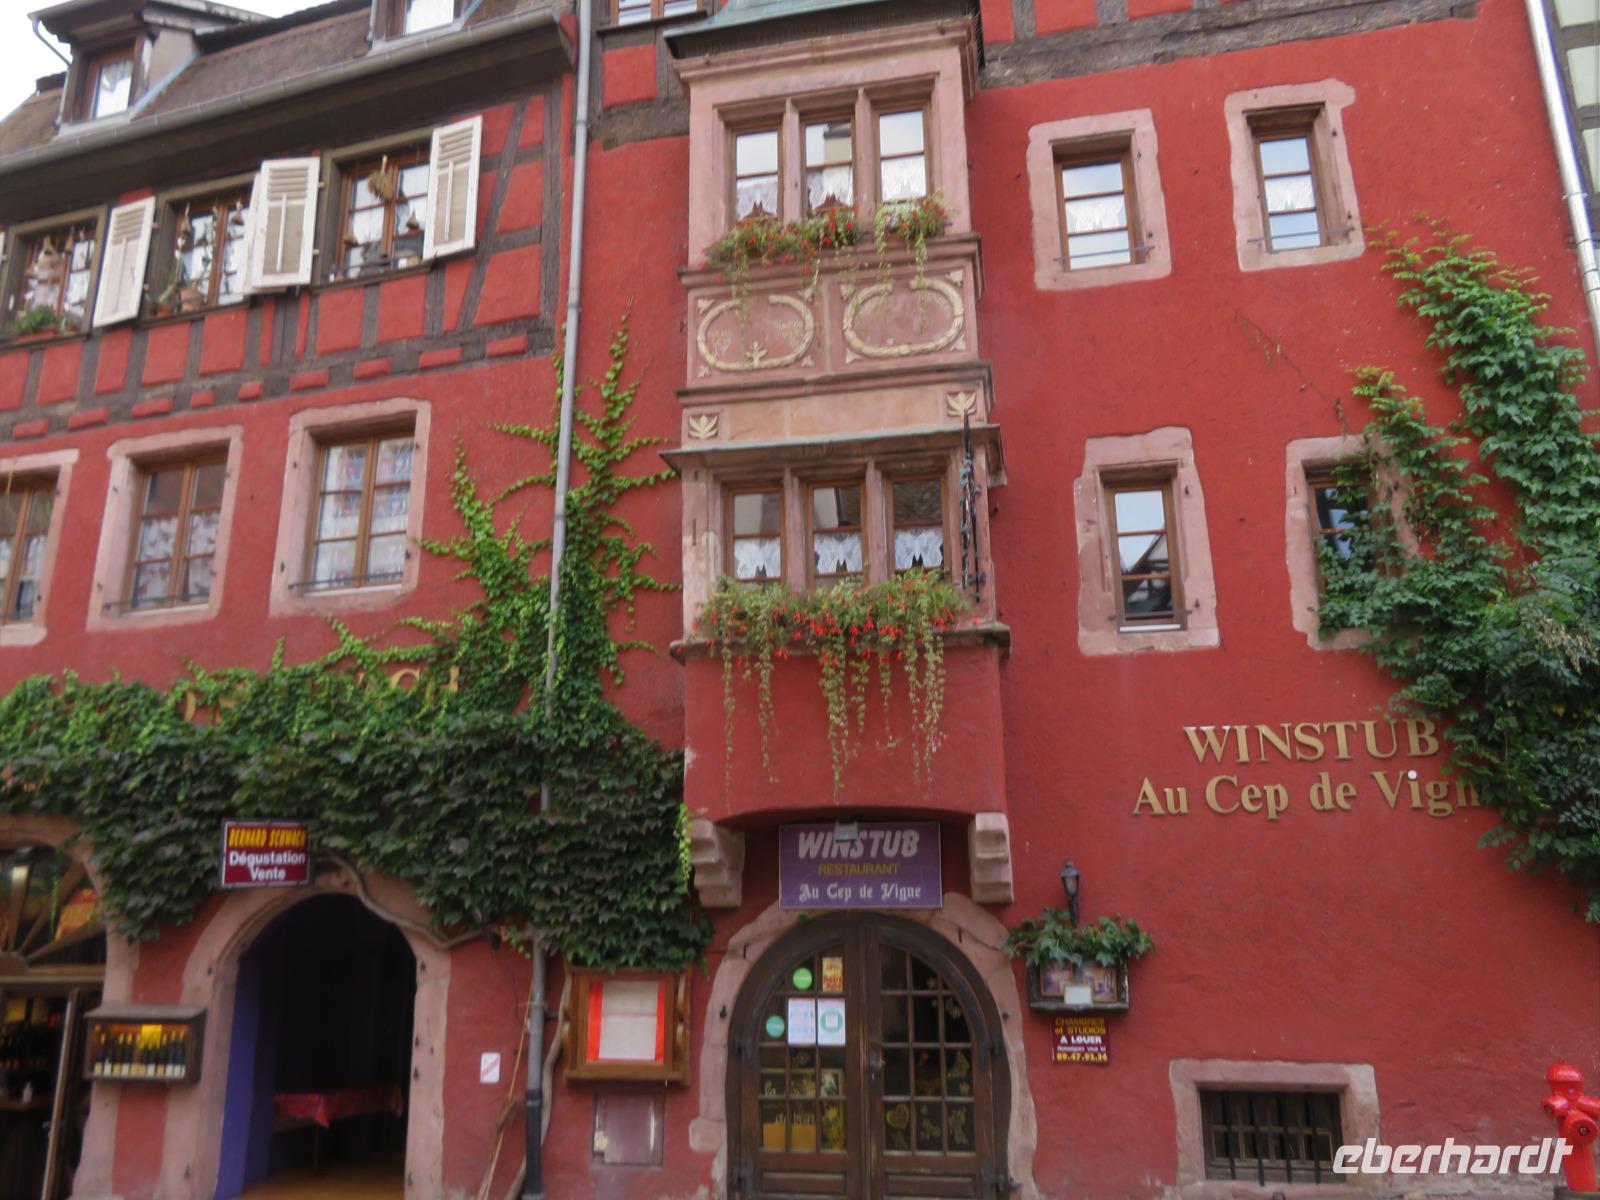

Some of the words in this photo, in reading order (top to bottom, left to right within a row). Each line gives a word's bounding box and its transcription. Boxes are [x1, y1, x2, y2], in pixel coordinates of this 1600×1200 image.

[1183, 718, 1440, 763] WINSTUB
[1131, 777, 1189, 816] Au
[1205, 775, 1288, 821] Cep
[1309, 771, 1357, 811] de
[1370, 770, 1481, 817] Vign
[798, 830, 920, 859] WINSTUB
[229, 850, 306, 868] Dégustation
[250, 866, 286, 881] Vente
[817, 863, 899, 875] RESTAURANT
[798, 884, 819, 903] Au
[826, 882, 852, 903] Cep
[859, 883, 873, 899] de
[881, 882, 921, 902] Vigne
[1071, 1035, 1102, 1044] LOUER
